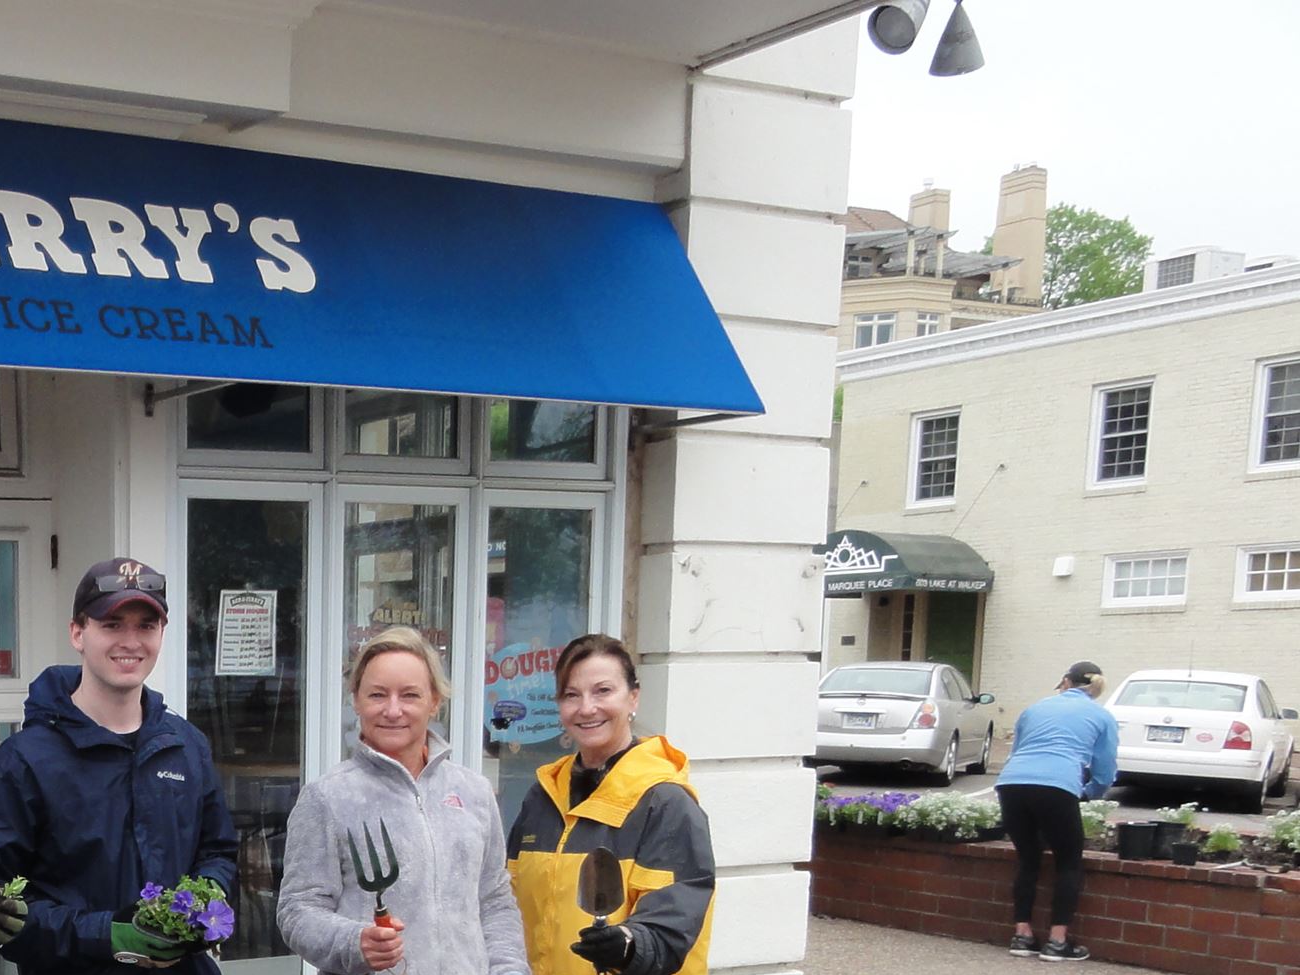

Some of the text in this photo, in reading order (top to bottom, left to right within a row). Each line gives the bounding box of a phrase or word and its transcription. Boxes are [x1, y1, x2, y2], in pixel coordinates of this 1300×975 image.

[3, 295, 83, 335] ICE
[98, 304, 274, 350] CREAM
[828, 578, 893, 591] MARQUEE PLACE
[929, 579, 946, 588] LAKE
[947, 580, 957, 588] AT
